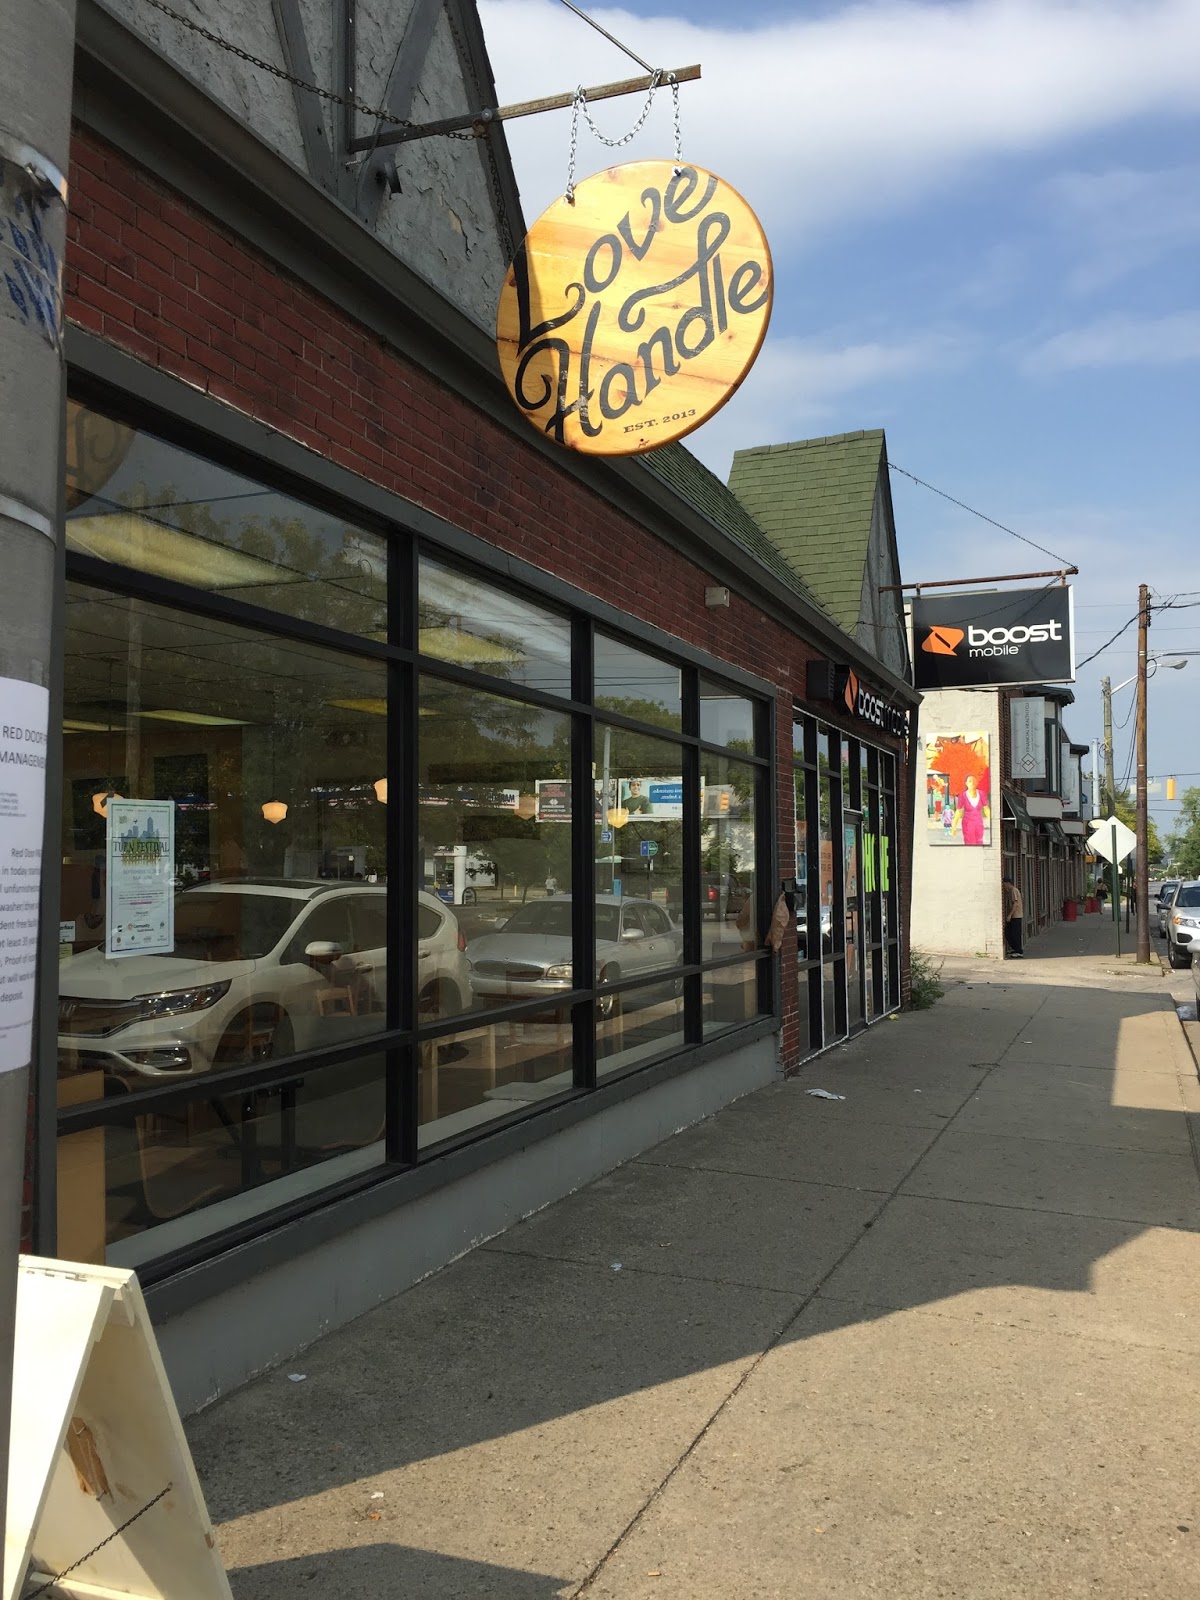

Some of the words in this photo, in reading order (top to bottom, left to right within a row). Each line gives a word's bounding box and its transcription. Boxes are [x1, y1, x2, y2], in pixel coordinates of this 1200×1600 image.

[513, 165, 719, 358] Love
[514, 211, 769, 444] Handle
[623, 419, 659, 434] EST.
[662, 409, 697, 424] 2013
[967, 619, 1062, 647] boost
[969, 645, 1019, 658] mobile
[3, 725, 23, 740] RED
